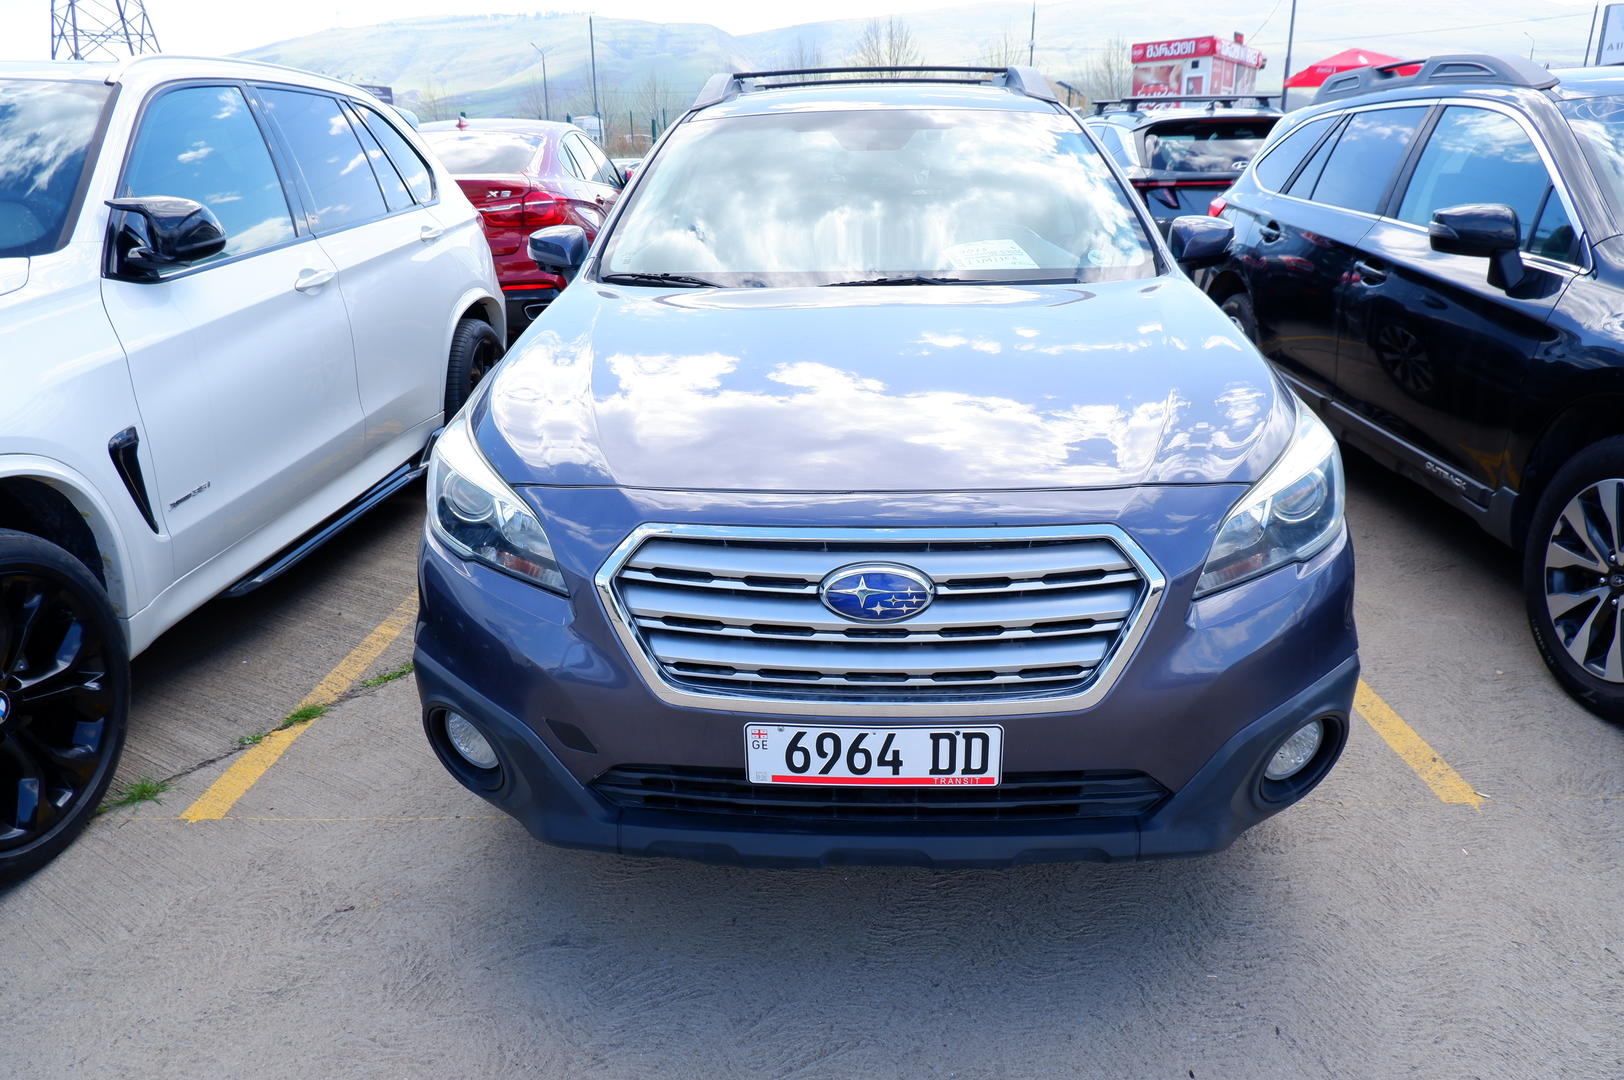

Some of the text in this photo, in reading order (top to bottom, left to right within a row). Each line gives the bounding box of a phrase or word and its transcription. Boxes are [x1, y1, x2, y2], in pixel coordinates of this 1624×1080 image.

[1425, 461, 1467, 490] OUTBACK
[752, 740, 769, 750] GE
[785, 731, 990, 776] 6964 DD
[933, 777, 981, 785] TRANSIT
